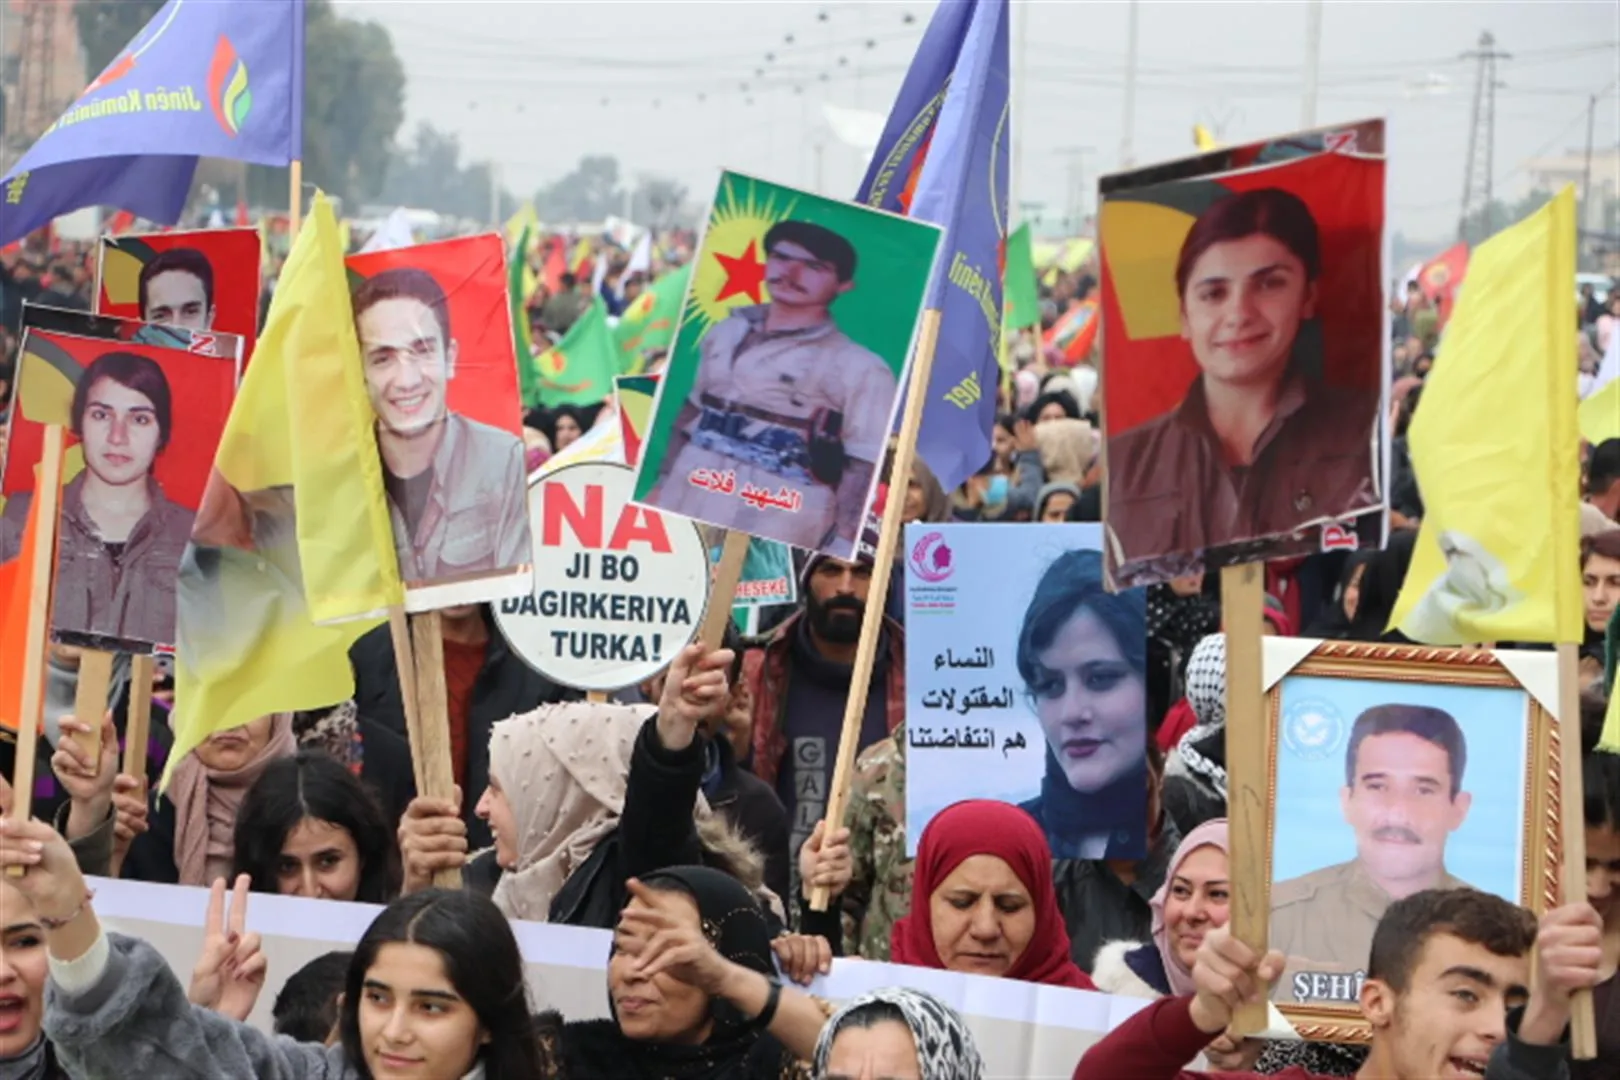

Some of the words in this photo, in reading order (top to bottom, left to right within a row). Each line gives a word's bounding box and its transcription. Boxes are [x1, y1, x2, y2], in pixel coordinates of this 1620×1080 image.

[688, 468, 736, 494] فلات
[740, 483, 802, 511] الشهيد
[542, 481, 672, 553] NA
[565, 553, 590, 579] JI
[602, 555, 639, 581] BO
[501, 590, 691, 625] DAGIRKERIYA
[551, 631, 662, 662] TURKA!
[934, 646, 994, 671] النساء
[921, 686, 1013, 716] المقتولات
[908, 725, 994, 749] انتفاضتنا
[1002, 731, 1026, 759] هم
